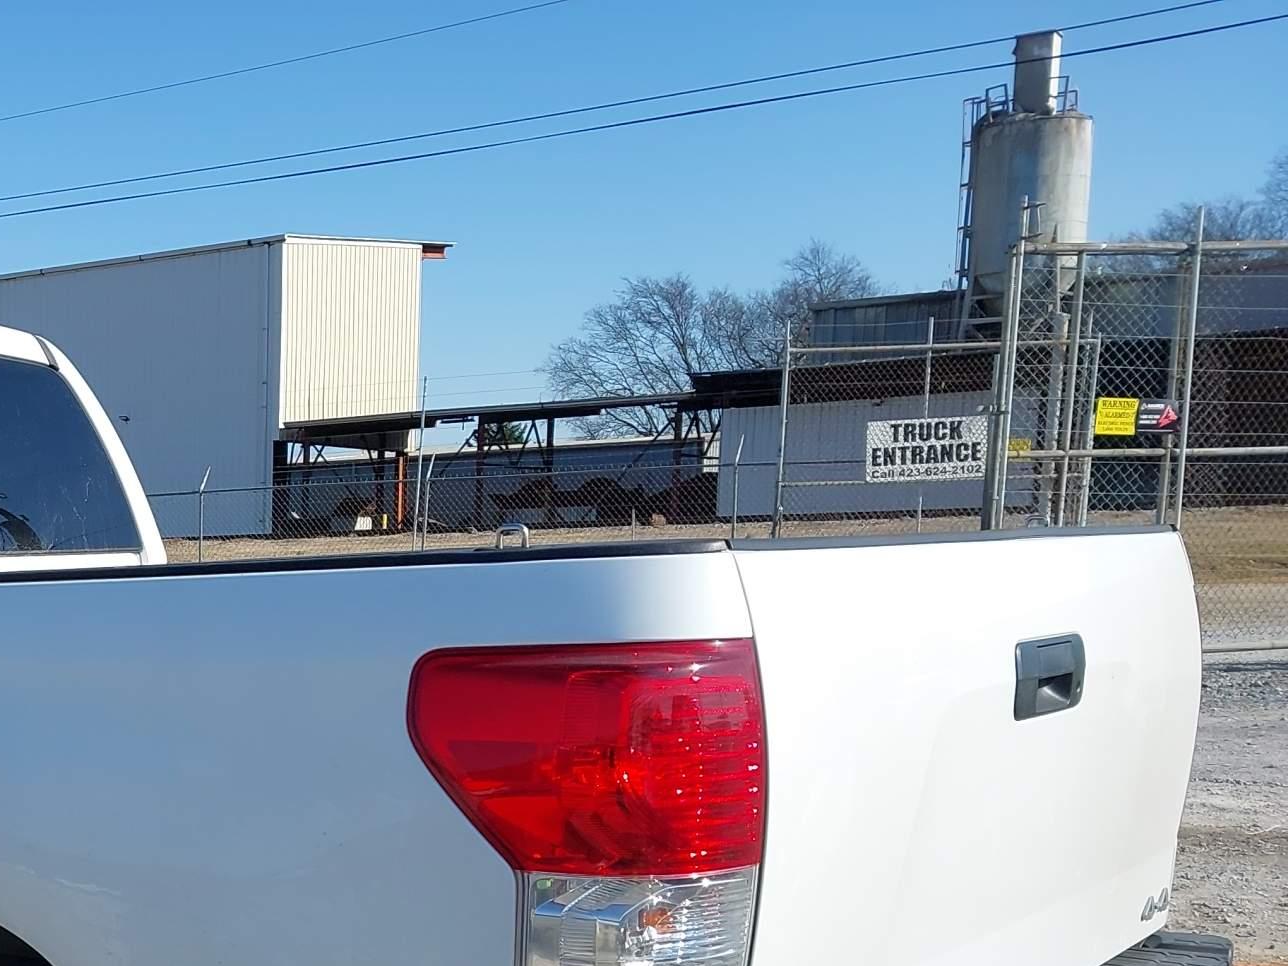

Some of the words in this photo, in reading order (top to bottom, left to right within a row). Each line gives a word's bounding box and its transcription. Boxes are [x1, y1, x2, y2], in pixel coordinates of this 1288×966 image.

[1102, 399, 1136, 409] WARNING
[890, 420, 964, 442] TRUCK
[871, 442, 981, 467] ENTRANCE
[871, 469, 895, 479] Call
[899, 464, 982, 478] 423-624-2102
